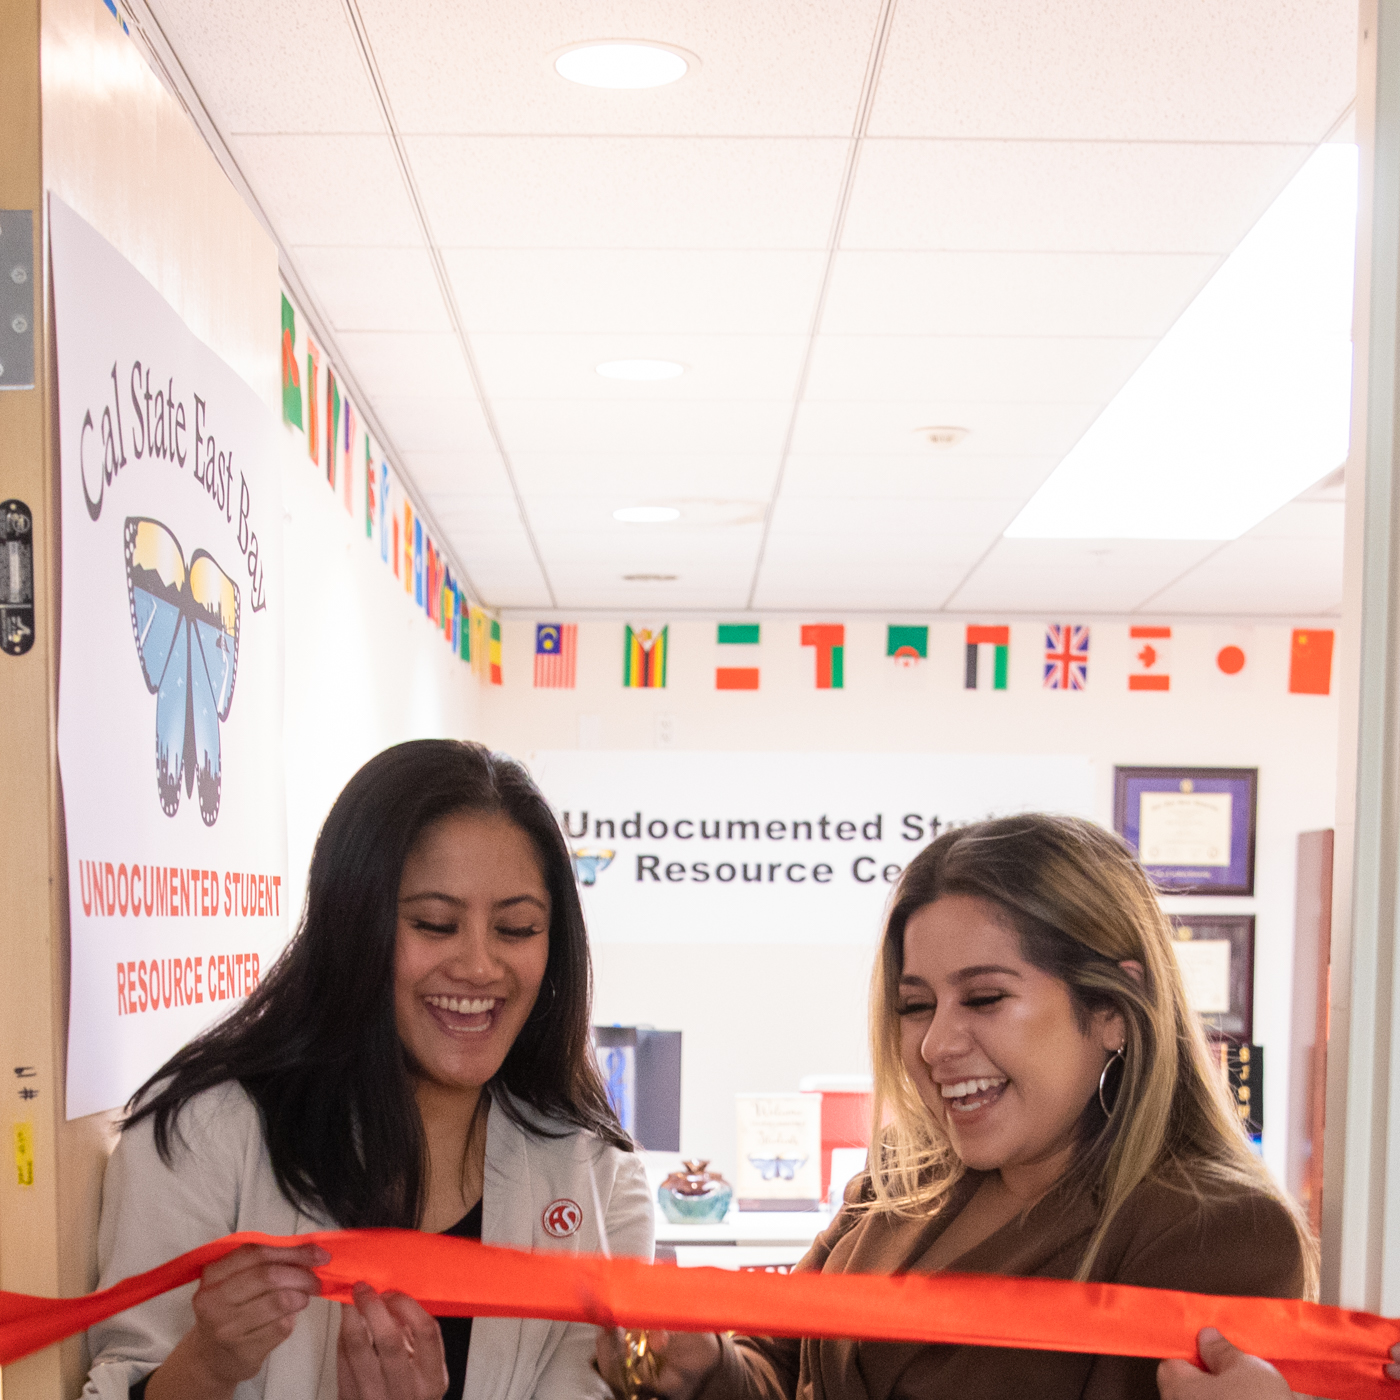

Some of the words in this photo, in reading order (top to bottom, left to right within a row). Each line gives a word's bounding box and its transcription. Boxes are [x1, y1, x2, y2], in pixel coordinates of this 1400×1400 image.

[80, 360, 127, 522] Cal
[131, 361, 187, 468] State
[193, 392, 233, 523] East
[237, 470, 267, 613] Bay
[562, 811, 883, 842] Undocumented
[79, 859, 220, 918] UNDOCUMENTED
[224, 871, 281, 917] STUDENT
[636, 854, 834, 883] Resource
[116, 956, 203, 1016] RESOURCE
[208, 952, 260, 1003] CENTER
